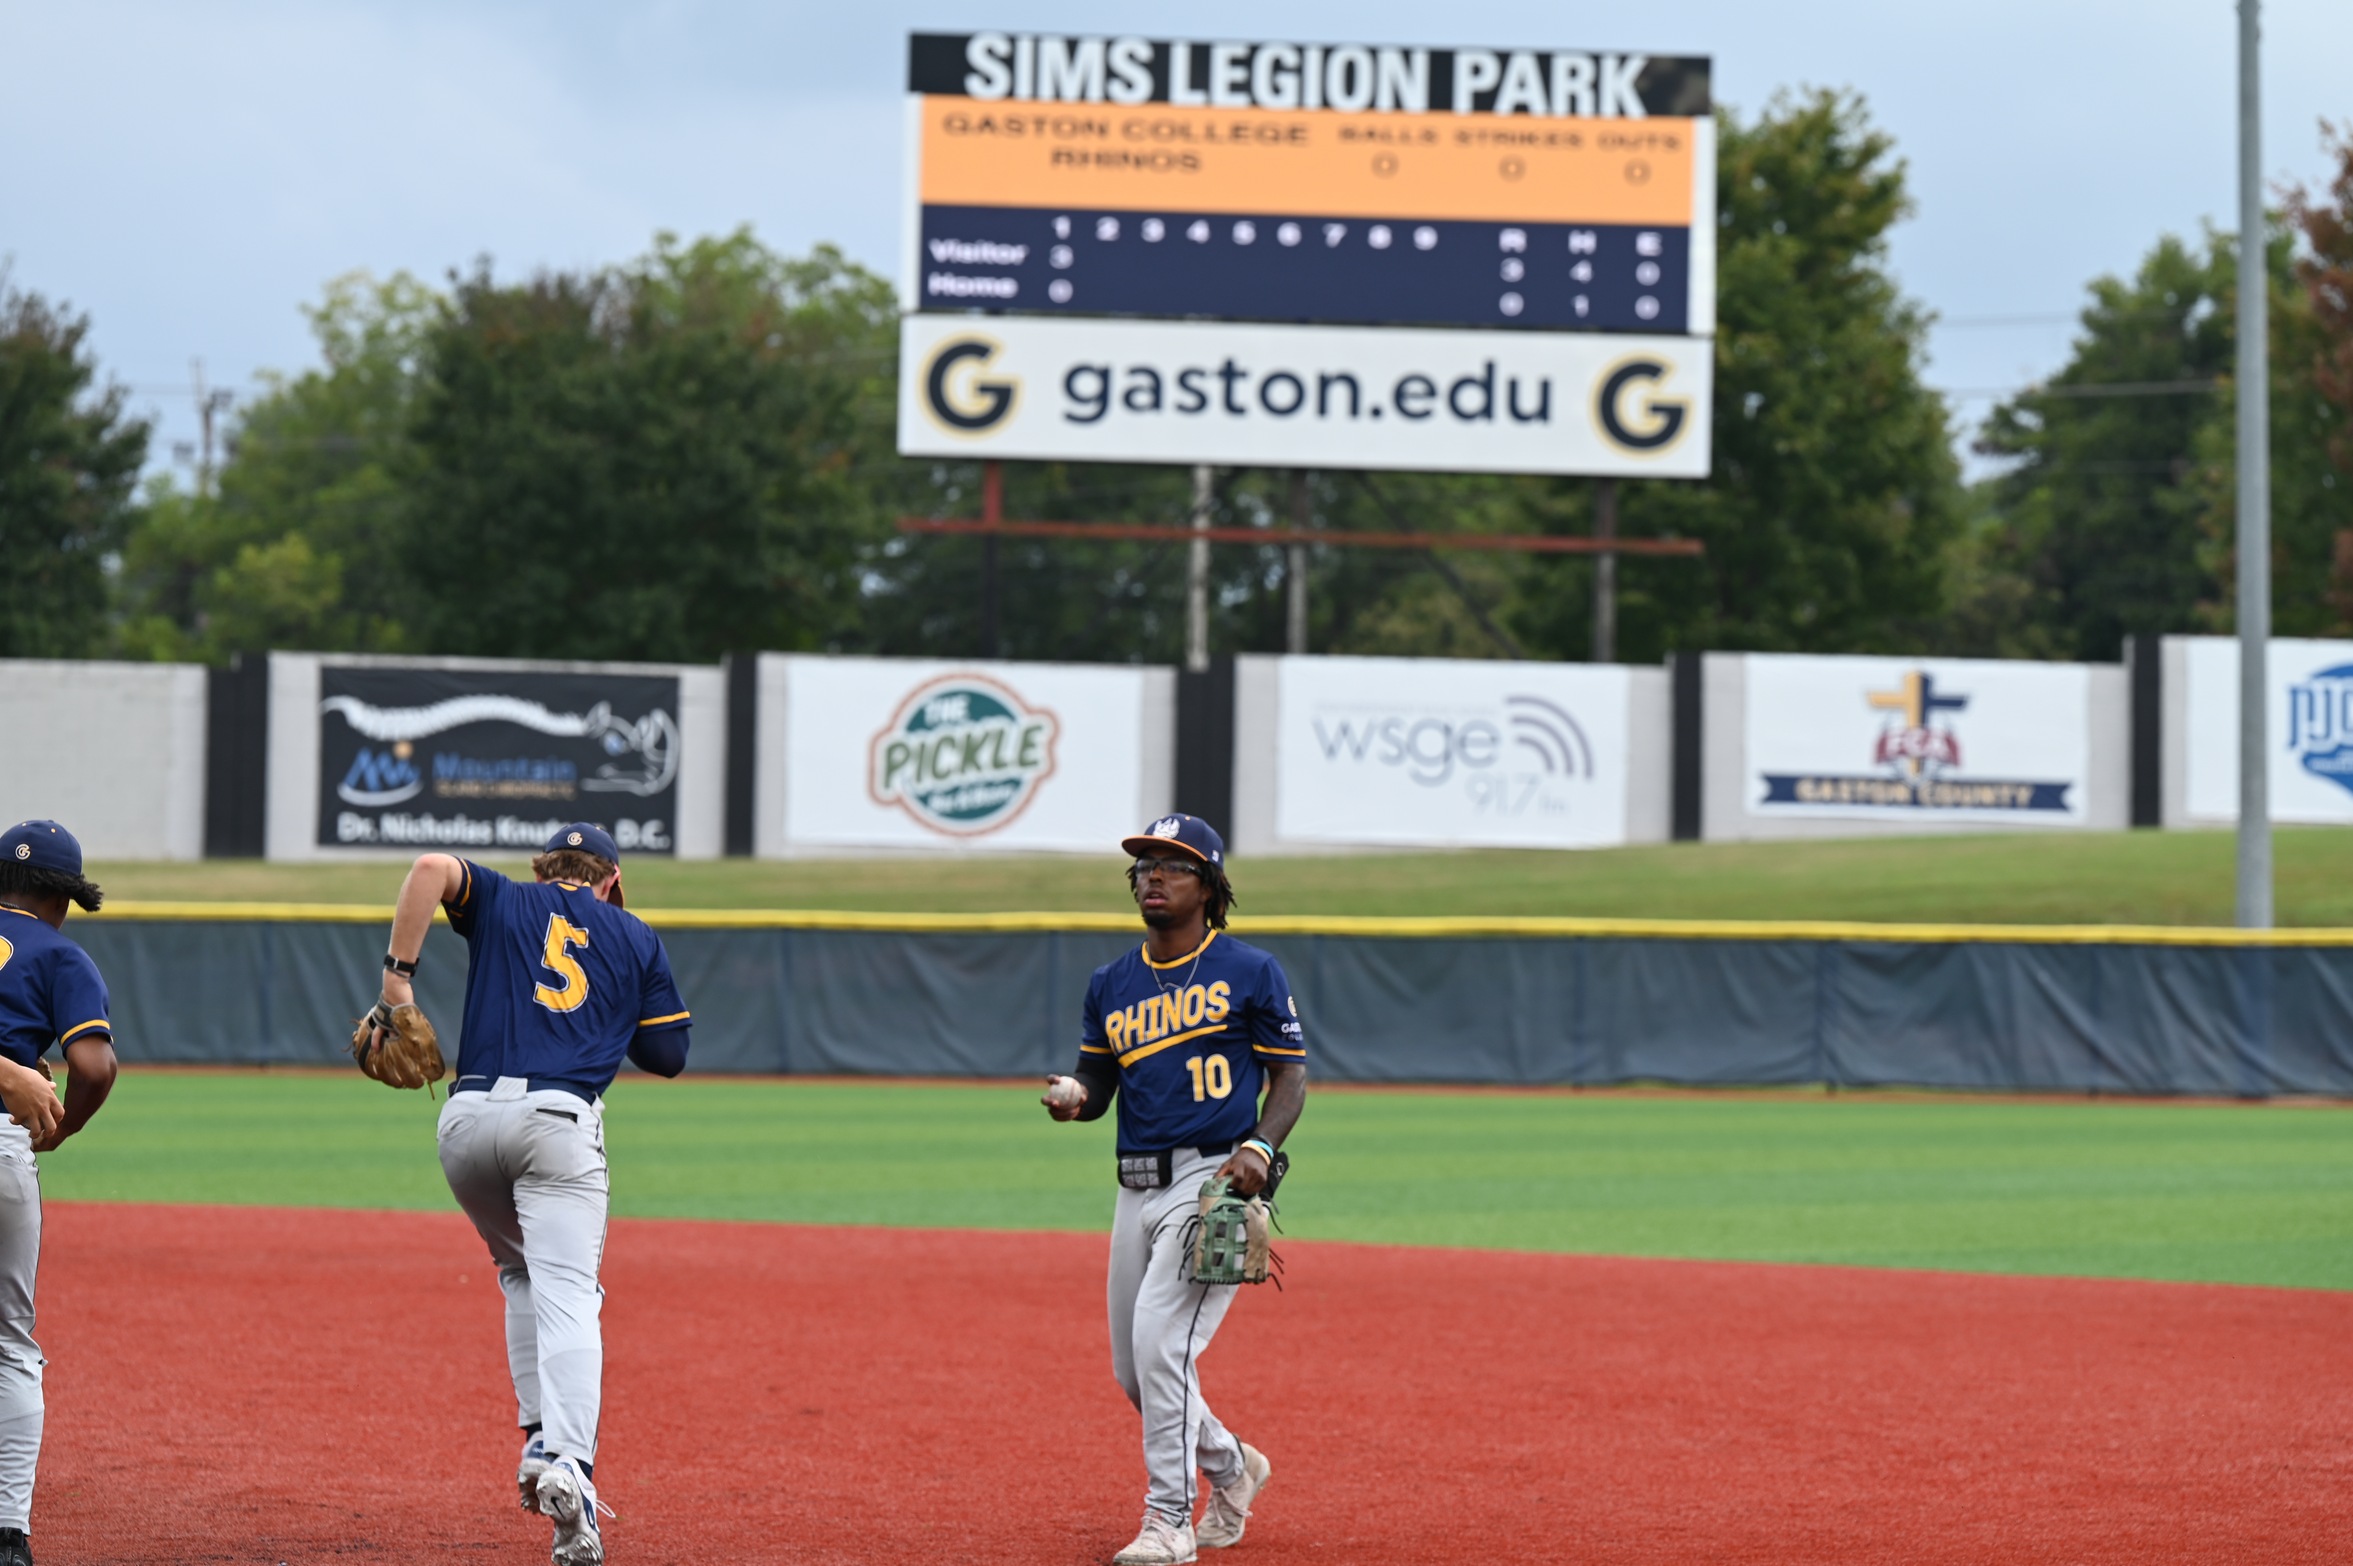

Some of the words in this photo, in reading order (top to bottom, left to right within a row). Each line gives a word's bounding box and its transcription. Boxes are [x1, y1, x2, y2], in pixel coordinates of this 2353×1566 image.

[964, 32, 1154, 104] SIMS
[1168, 42, 1430, 112] LEGION
[1450, 50, 1648, 119] PARK
[942, 114, 1109, 138] GASTON
[1121, 120, 1310, 144] COLLEGE
[1338, 126, 1439, 146] BALLS
[1453, 129, 1584, 149] STRIKES
[1598, 135, 1681, 152] OUTS
[1051, 148, 1201, 172] RHINOS
[1052, 215, 1071, 240] 1
[1096, 216, 1120, 241] 2
[1140, 218, 1165, 243] 3
[1186, 219, 1210, 244] 4
[1323, 223, 1347, 247] 7
[1500, 228, 1527, 253] R
[1569, 230, 1597, 254] H
[1636, 232, 1662, 256] E
[928, 238, 1029, 265] Visitor
[1569, 259, 1593, 284] 4
[928, 271, 1018, 299] Home
[922, 336, 1019, 434] G
[1061, 360, 1554, 425] gaston.edu
[1597, 354, 1690, 453] G
[924, 696, 968, 725] THE
[432, 752, 577, 783] Mountain
[884, 724, 1043, 789] PICKLE
[1311, 715, 1500, 788] wsge
[1795, 777, 1911, 803] GASTON
[1916, 780, 2033, 807] COUNTY
[337, 811, 380, 842] Dr.
[380, 813, 493, 846] Nicholas
[614, 818, 671, 849] D.C.
[533, 912, 589, 1013] 5
[1105, 980, 1231, 1056] RHINOS
[1185, 1053, 1233, 1102] 10
